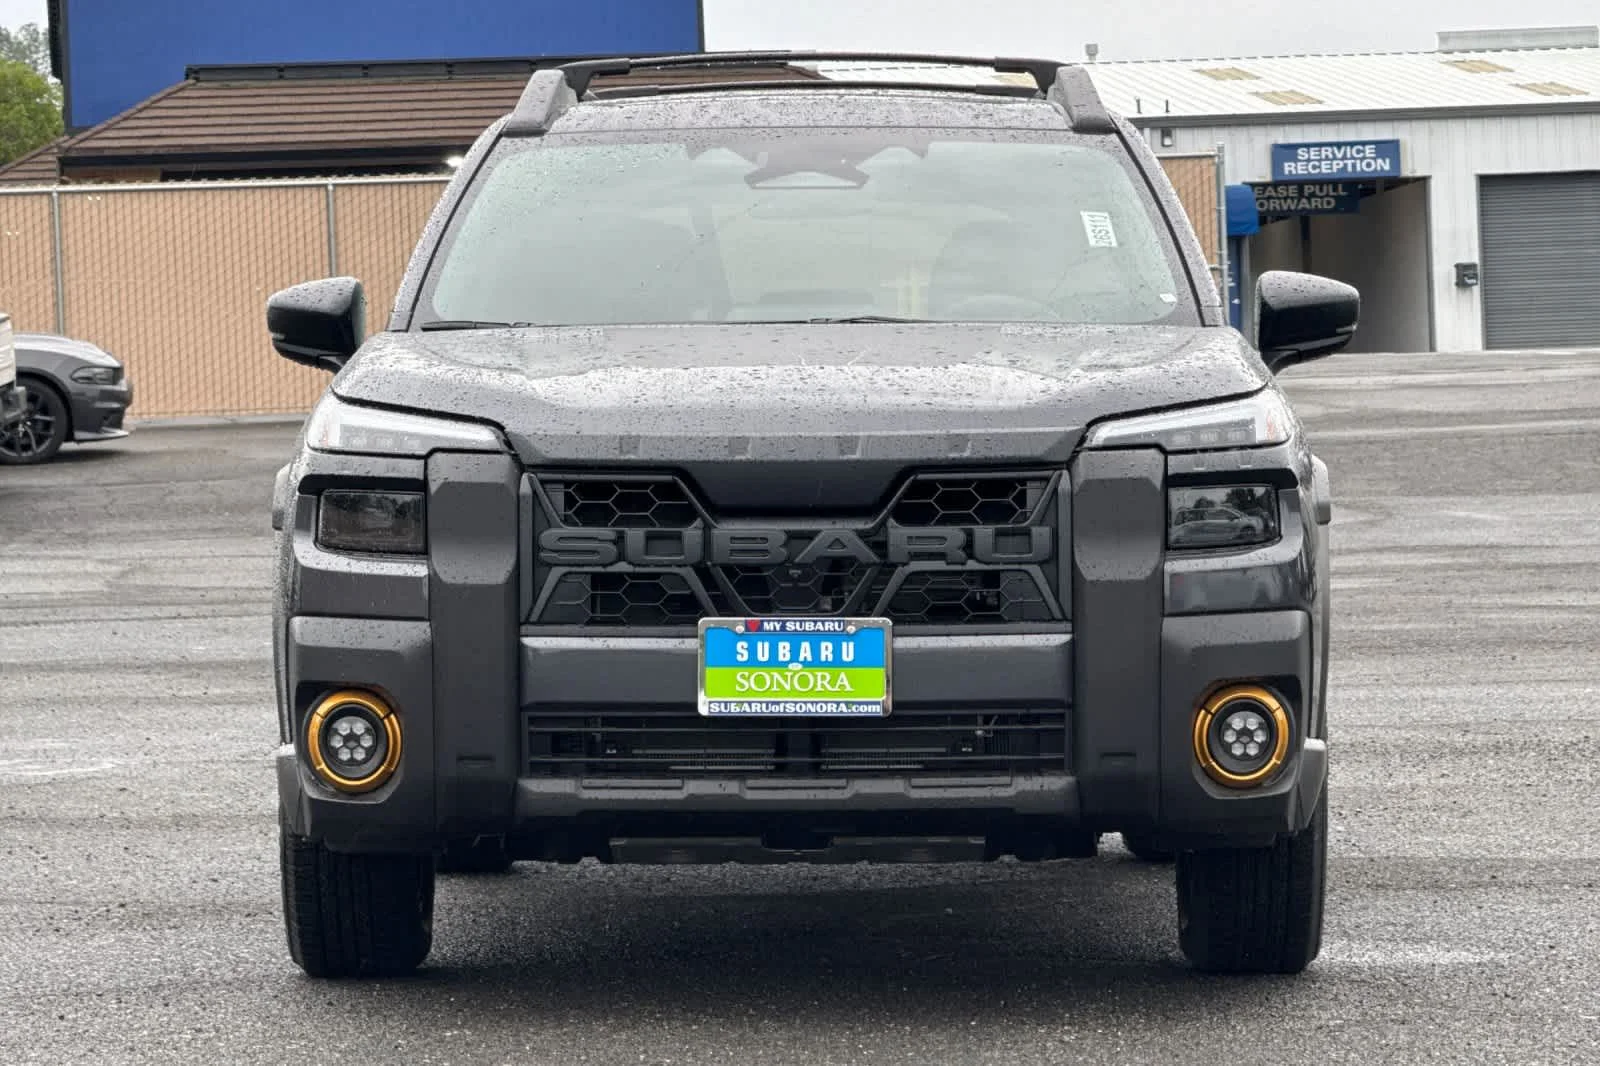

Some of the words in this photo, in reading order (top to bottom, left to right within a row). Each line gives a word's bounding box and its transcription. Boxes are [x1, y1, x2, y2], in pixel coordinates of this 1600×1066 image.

[1297, 145, 1376, 160] SERVICE
[1284, 158, 1391, 175] RECEPTION
[1255, 185, 1300, 198] EASE
[1304, 184, 1347, 197] PULL
[1256, 197, 1336, 212] ORWARD
[538, 526, 1053, 565] SUBARU
[763, 621, 782, 631] MY
[785, 620, 844, 632] SUBARU
[736, 641, 855, 662] SUBARU
[735, 671, 854, 692] SONORA
[709, 702, 881, 713] SUBARUofSONORA.com
